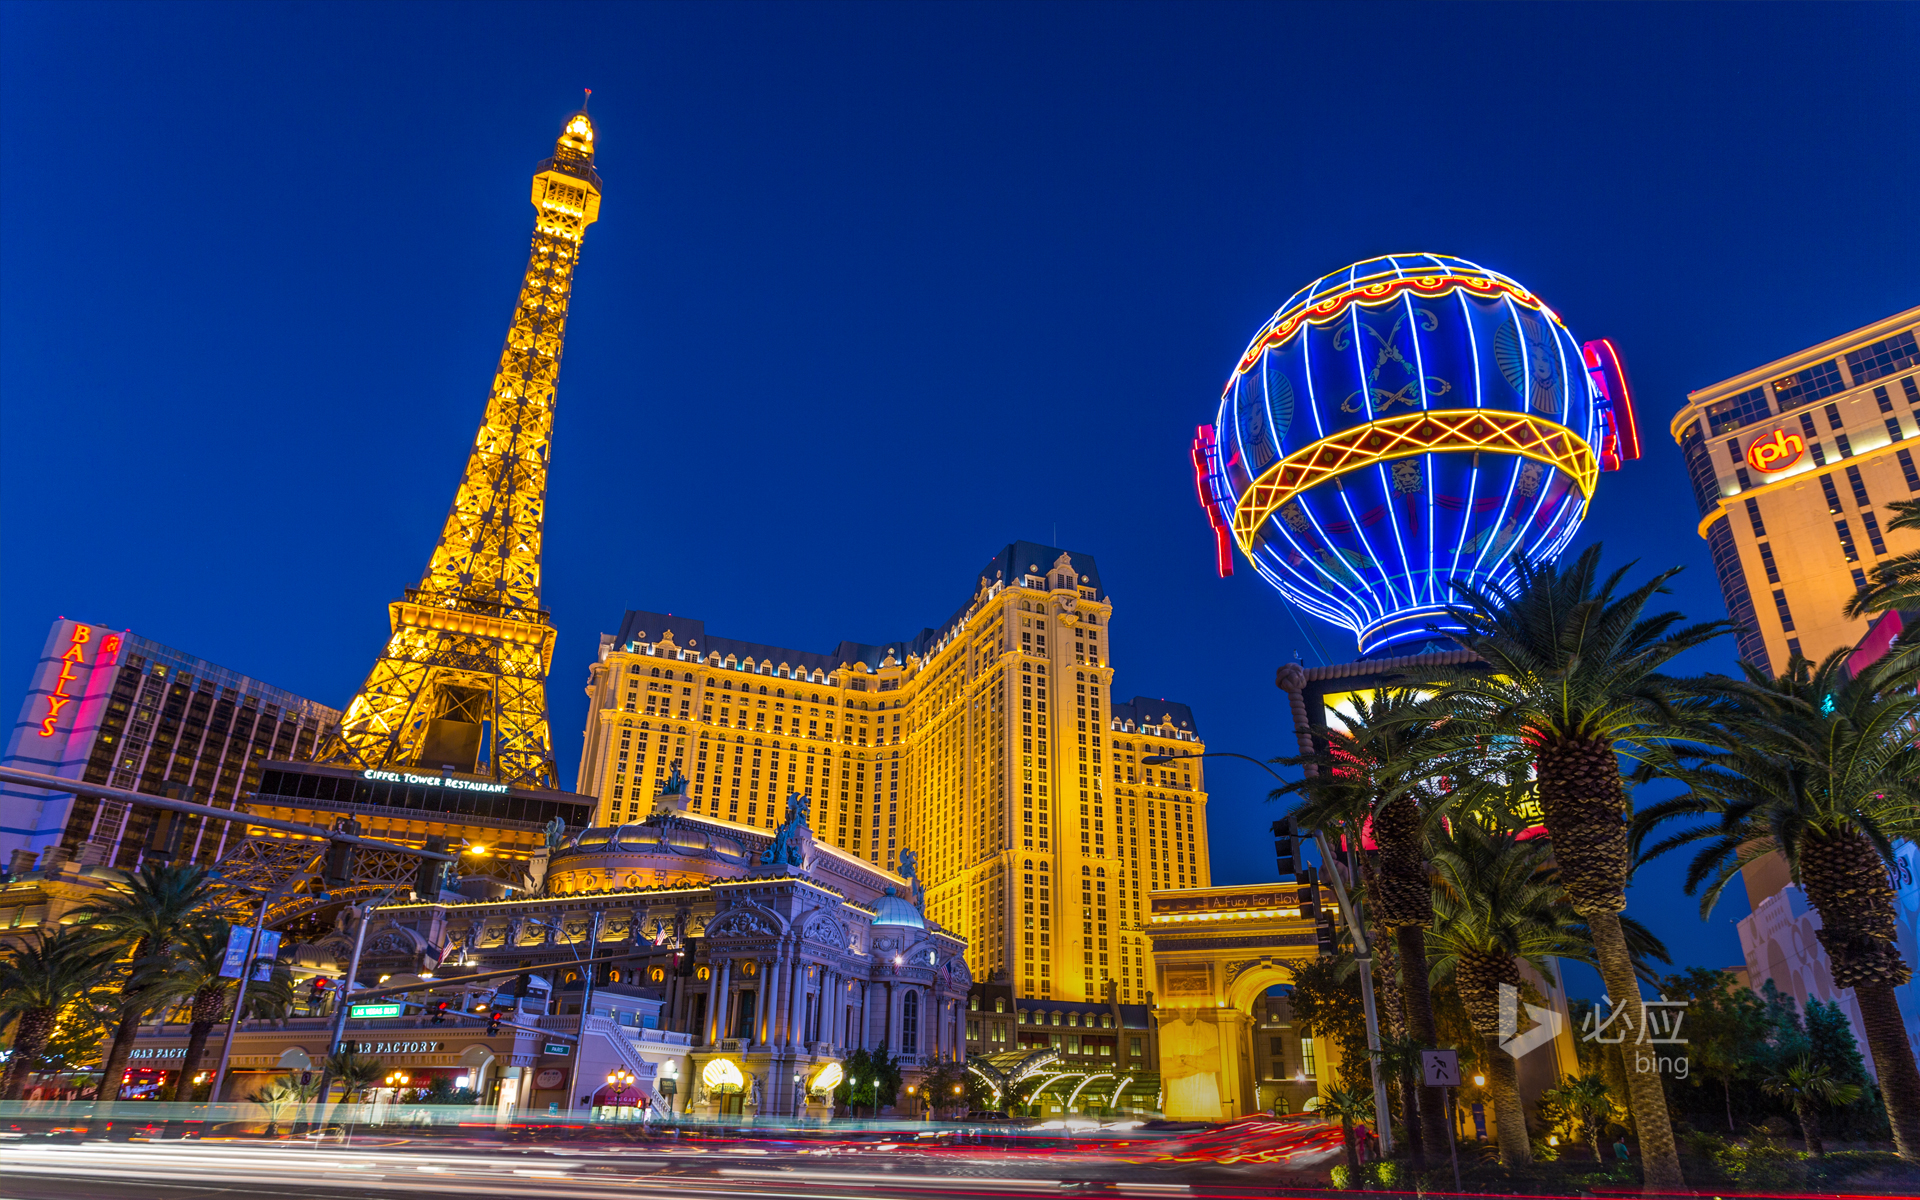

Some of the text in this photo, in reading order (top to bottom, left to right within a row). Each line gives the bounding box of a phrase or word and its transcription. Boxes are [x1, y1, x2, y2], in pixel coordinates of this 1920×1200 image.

[1751, 428, 1804, 470] ph
[364, 769, 508, 794] EIFFEL TOWER RESTAURANT
[1213, 893, 1299, 908] A Fury For Flav
[353, 1008, 364, 1016] LAS
[365, 1007, 383, 1015] VEGAS
[375, 1041, 437, 1054] FACTORY
